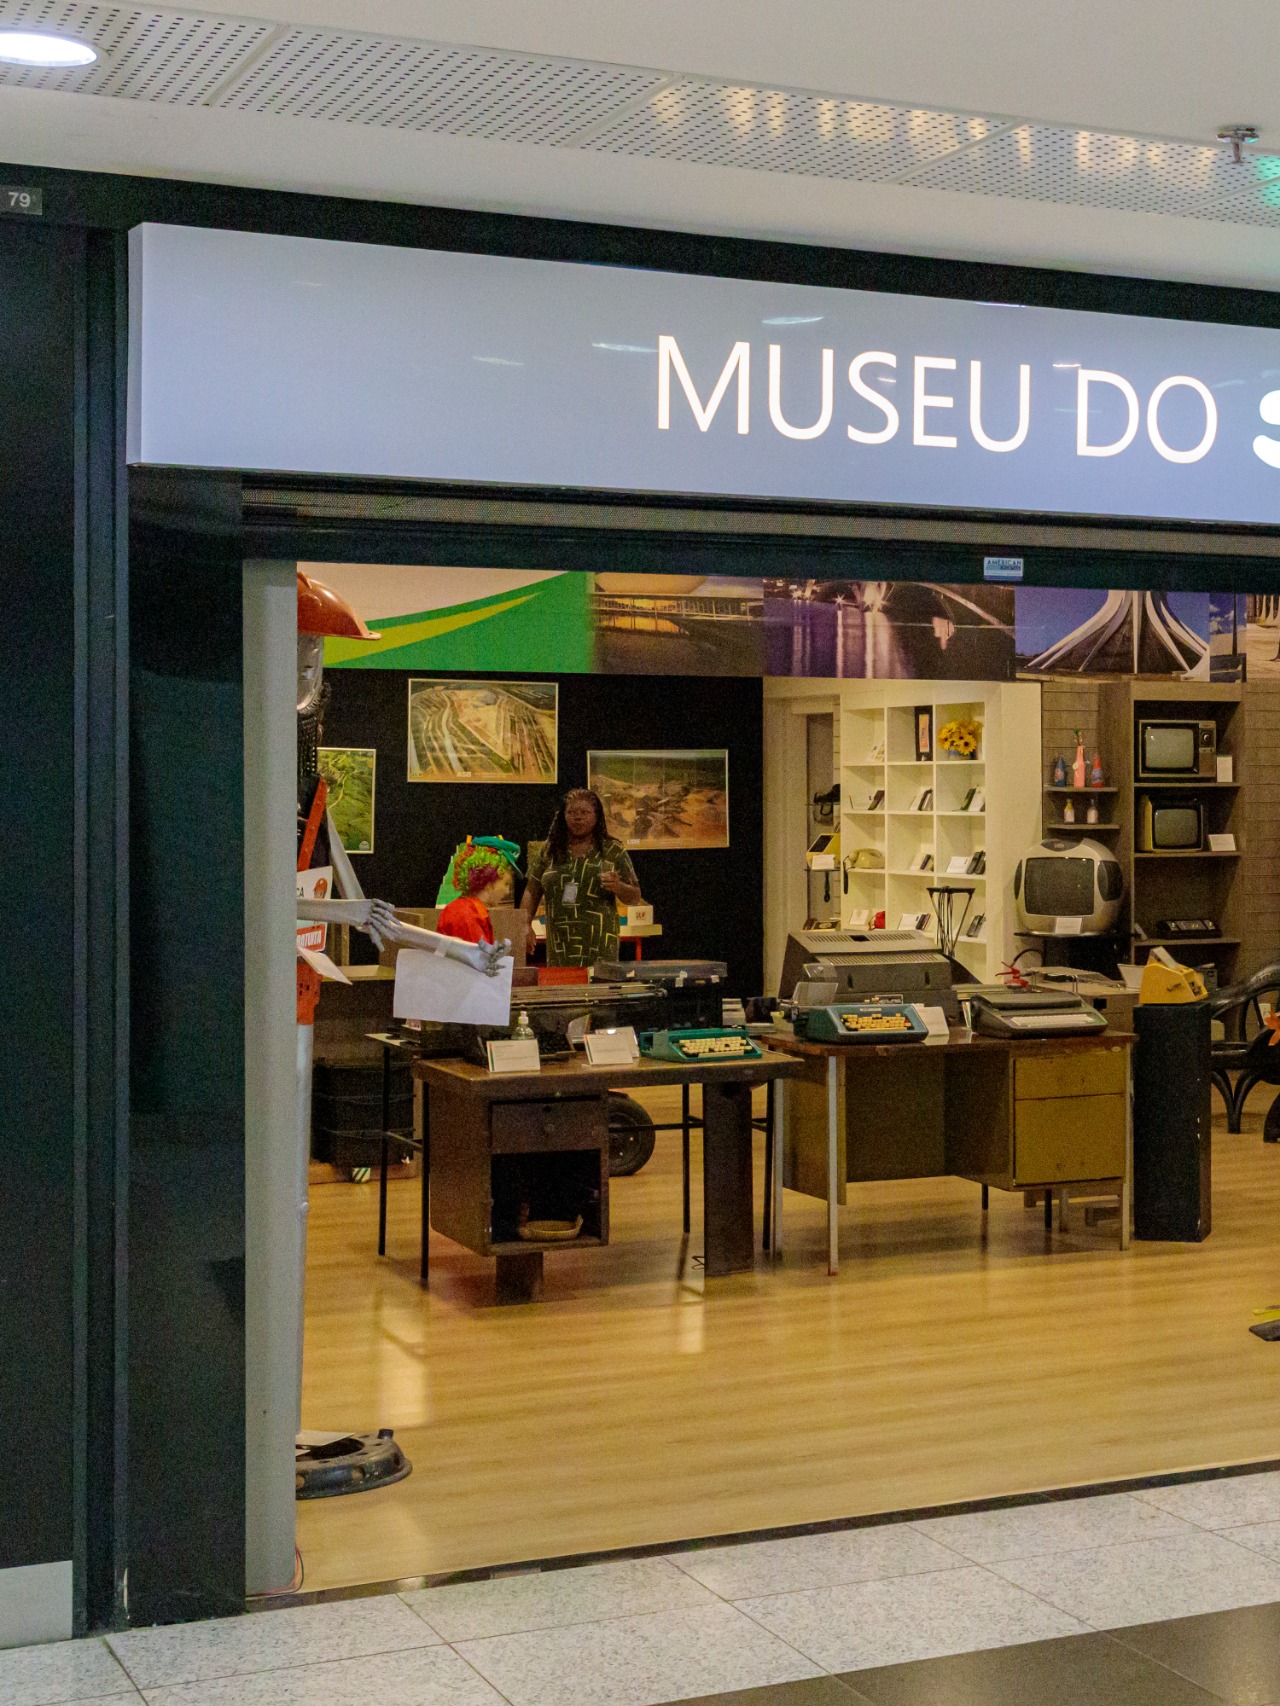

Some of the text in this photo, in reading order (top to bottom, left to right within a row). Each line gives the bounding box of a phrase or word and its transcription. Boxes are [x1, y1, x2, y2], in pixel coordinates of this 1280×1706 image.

[8, 192, 32, 208] 79
[656, 334, 1031, 454] MUSEU
[1077, 367, 1219, 466] DO
